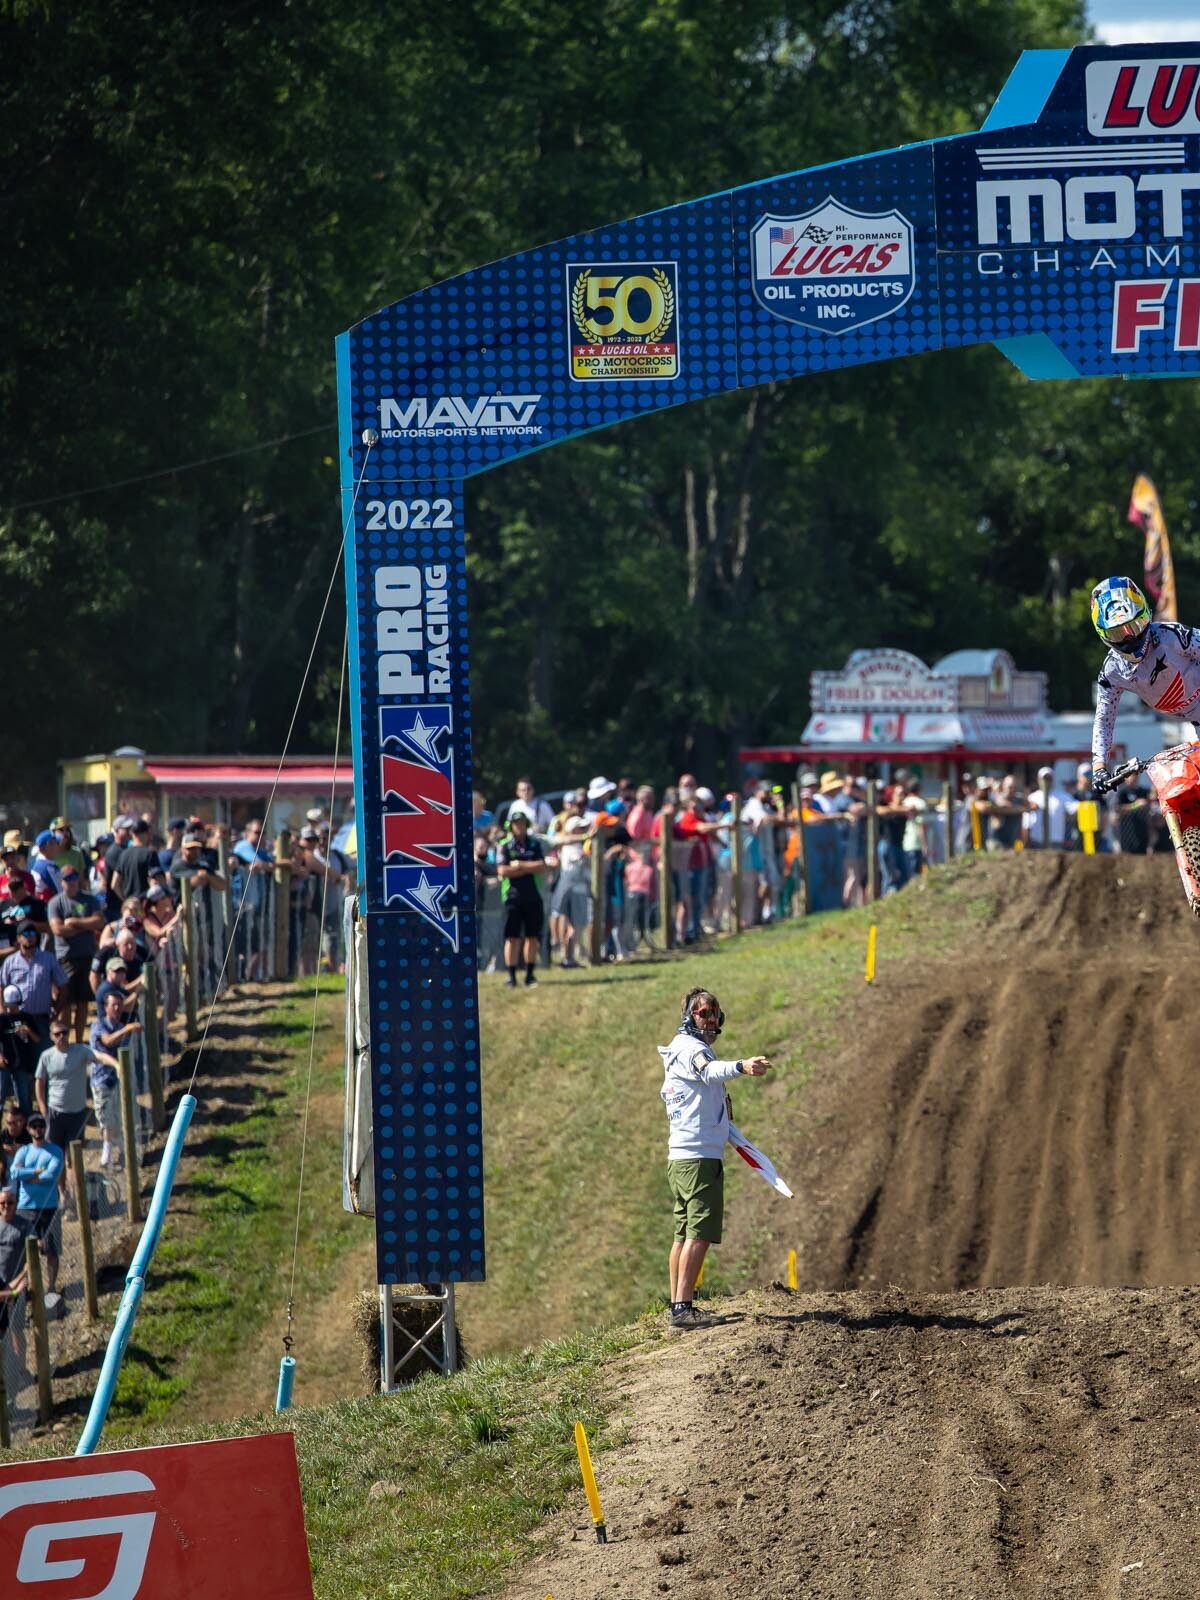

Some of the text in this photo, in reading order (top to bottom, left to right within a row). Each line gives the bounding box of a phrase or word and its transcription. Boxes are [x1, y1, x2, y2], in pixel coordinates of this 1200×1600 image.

[835, 232, 903, 240] PERFORMANCE
[771, 243, 900, 276] LUCAS
[764, 282, 904, 300] OIL PRODUCTS
[585, 275, 665, 337] 50
[577, 356, 672, 367] PRO MOTOCROSS
[601, 345, 648, 355] LUCAS OIL
[591, 367, 660, 375] CHAMPIONSHIP
[380, 395, 542, 429] MAVTV
[381, 426, 543, 438] MOTORSPORTS NETWORK
[366, 499, 453, 530] 2022
[375, 565, 425, 694] PRO
[425, 564, 451, 694] RACING
